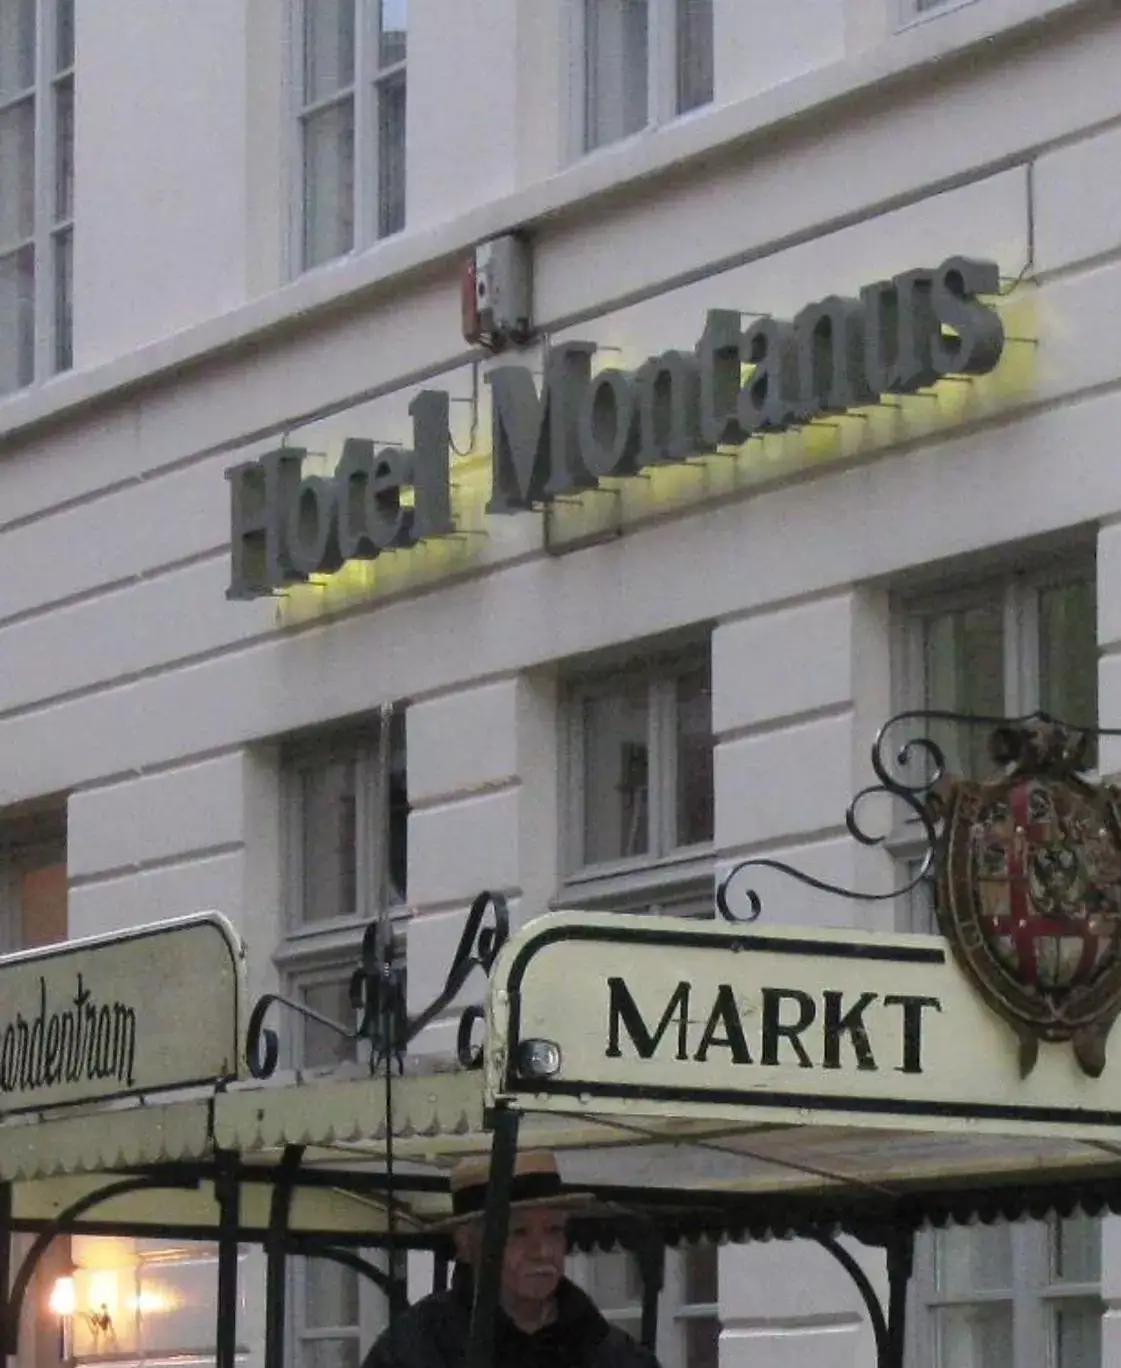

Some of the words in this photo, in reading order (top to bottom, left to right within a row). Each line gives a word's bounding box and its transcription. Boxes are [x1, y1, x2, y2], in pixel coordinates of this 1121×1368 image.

[225, 389, 455, 600] Hotel
[485, 256, 1005, 515] Montanus
[0, 972, 136, 1092] ardentram
[605, 976, 942, 1074] MARKT
